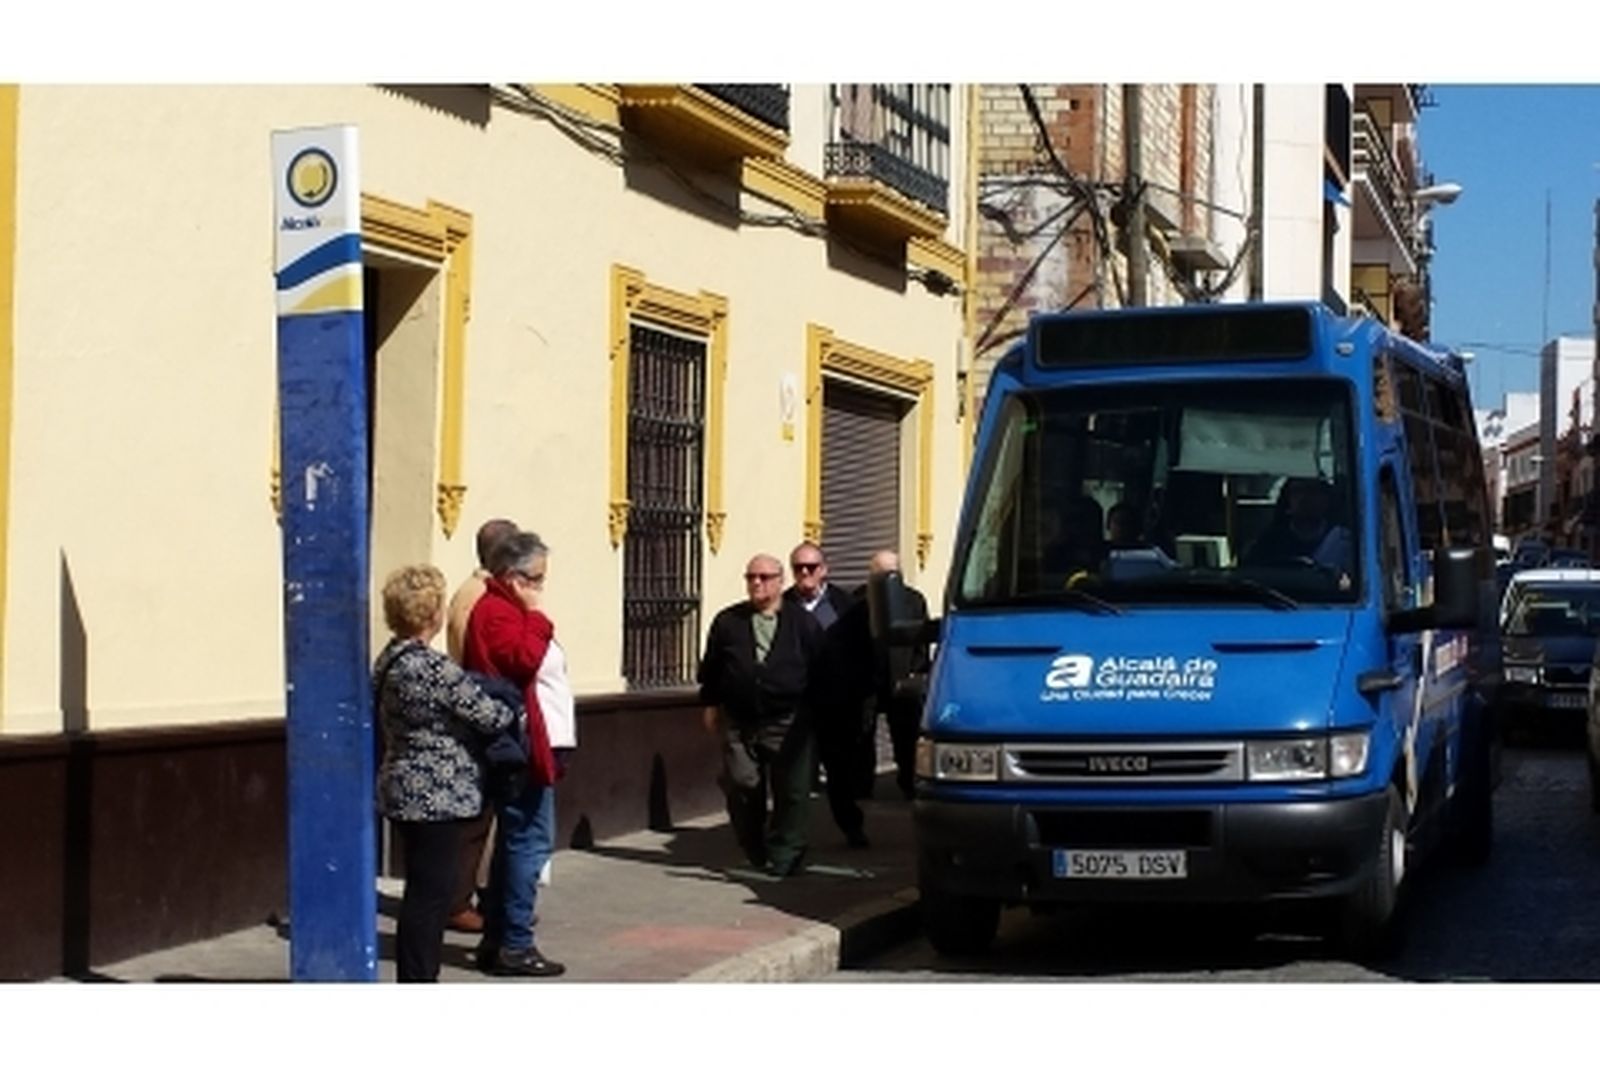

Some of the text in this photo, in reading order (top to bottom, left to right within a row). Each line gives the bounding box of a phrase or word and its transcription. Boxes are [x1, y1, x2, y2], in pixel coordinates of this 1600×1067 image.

[1100, 656, 1218, 672] Alcalá de
[1089, 756, 1149, 772] IVECO
[1072, 852, 1128, 875] 5075
[1139, 853, 1181, 875] DSV
